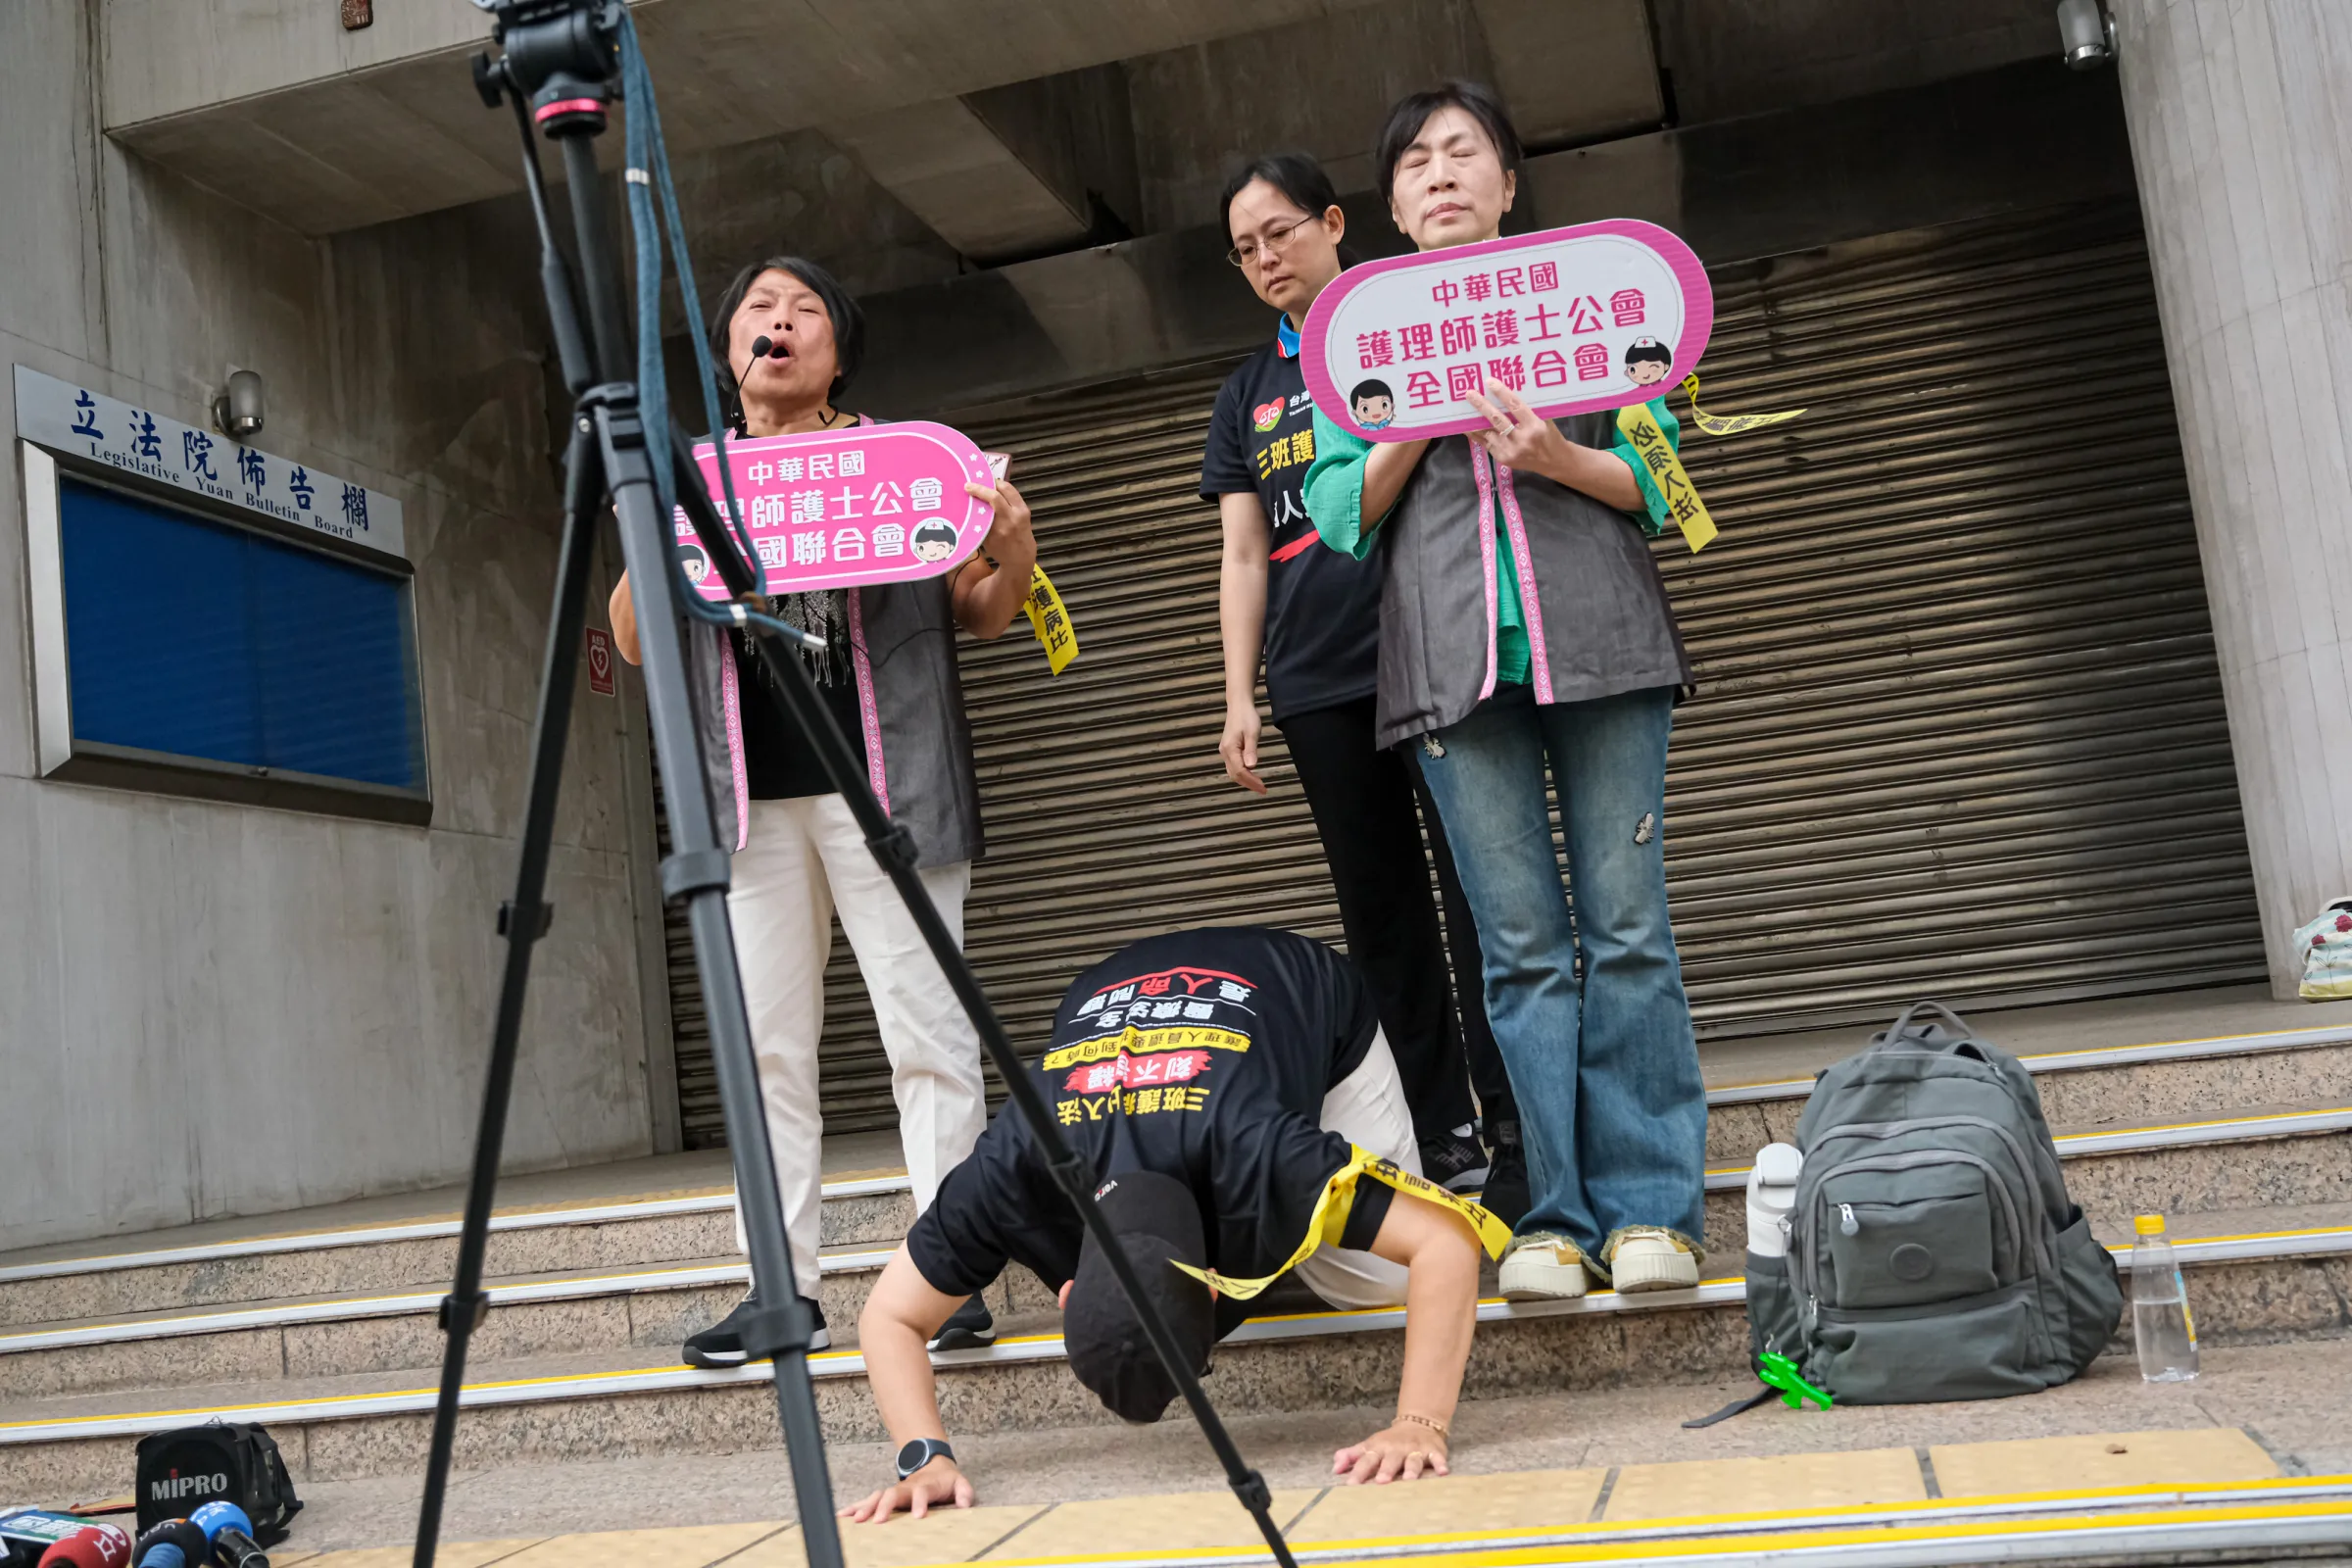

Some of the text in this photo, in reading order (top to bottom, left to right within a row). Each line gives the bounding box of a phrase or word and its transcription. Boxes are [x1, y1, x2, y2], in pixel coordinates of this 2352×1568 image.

[1432, 260, 1559, 309] 中華民國
[1356, 287, 1646, 369] 護理師護士公會
[1406, 342, 1608, 410] 全國聯合會
[71, 389, 368, 531] 立法院佈告欄
[748, 450, 865, 486] 中華民國
[1256, 428, 1315, 481] 三班護
[91, 442, 354, 539] Legislative Yuan Bulletin Board
[713, 522, 906, 574] 國聯合會
[591, 635, 606, 647] AED
